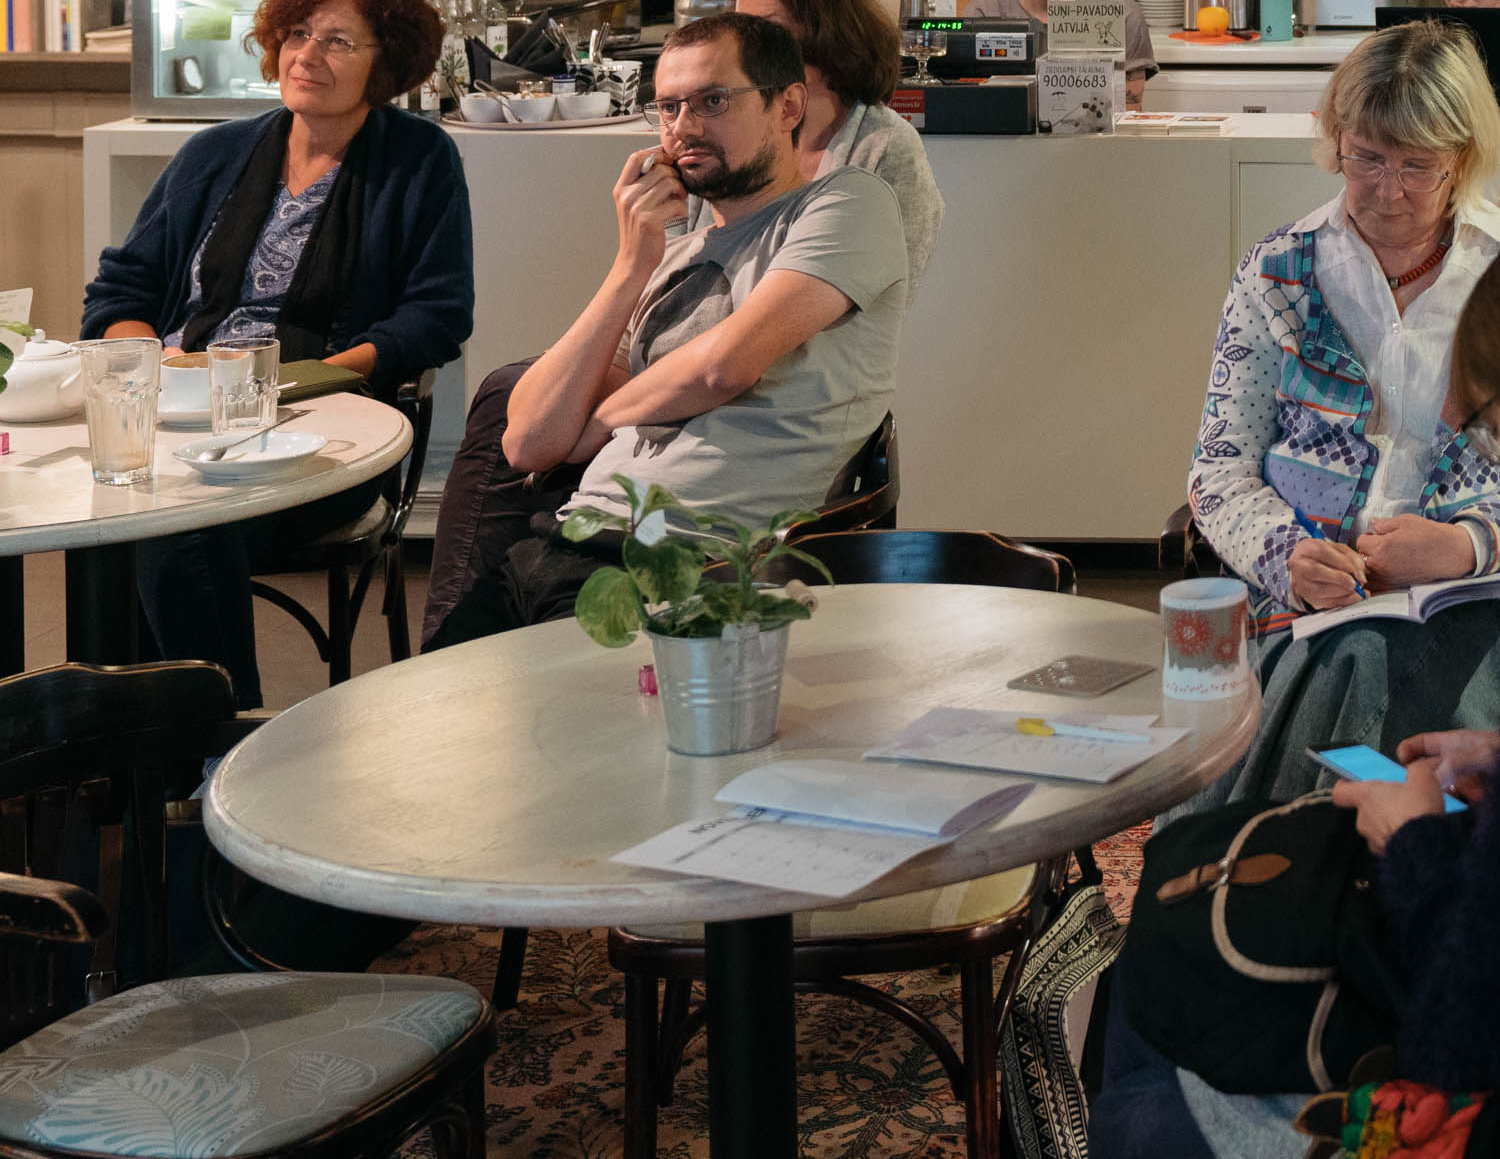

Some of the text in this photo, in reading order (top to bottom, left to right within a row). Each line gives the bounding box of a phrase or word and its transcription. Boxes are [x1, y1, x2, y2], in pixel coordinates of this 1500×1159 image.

[1047, 4, 1125, 21] SUŅI-PAVADOŅI
[1052, 18, 1091, 34] LATVIJĀ
[1043, 74, 1108, 89] 90006683
